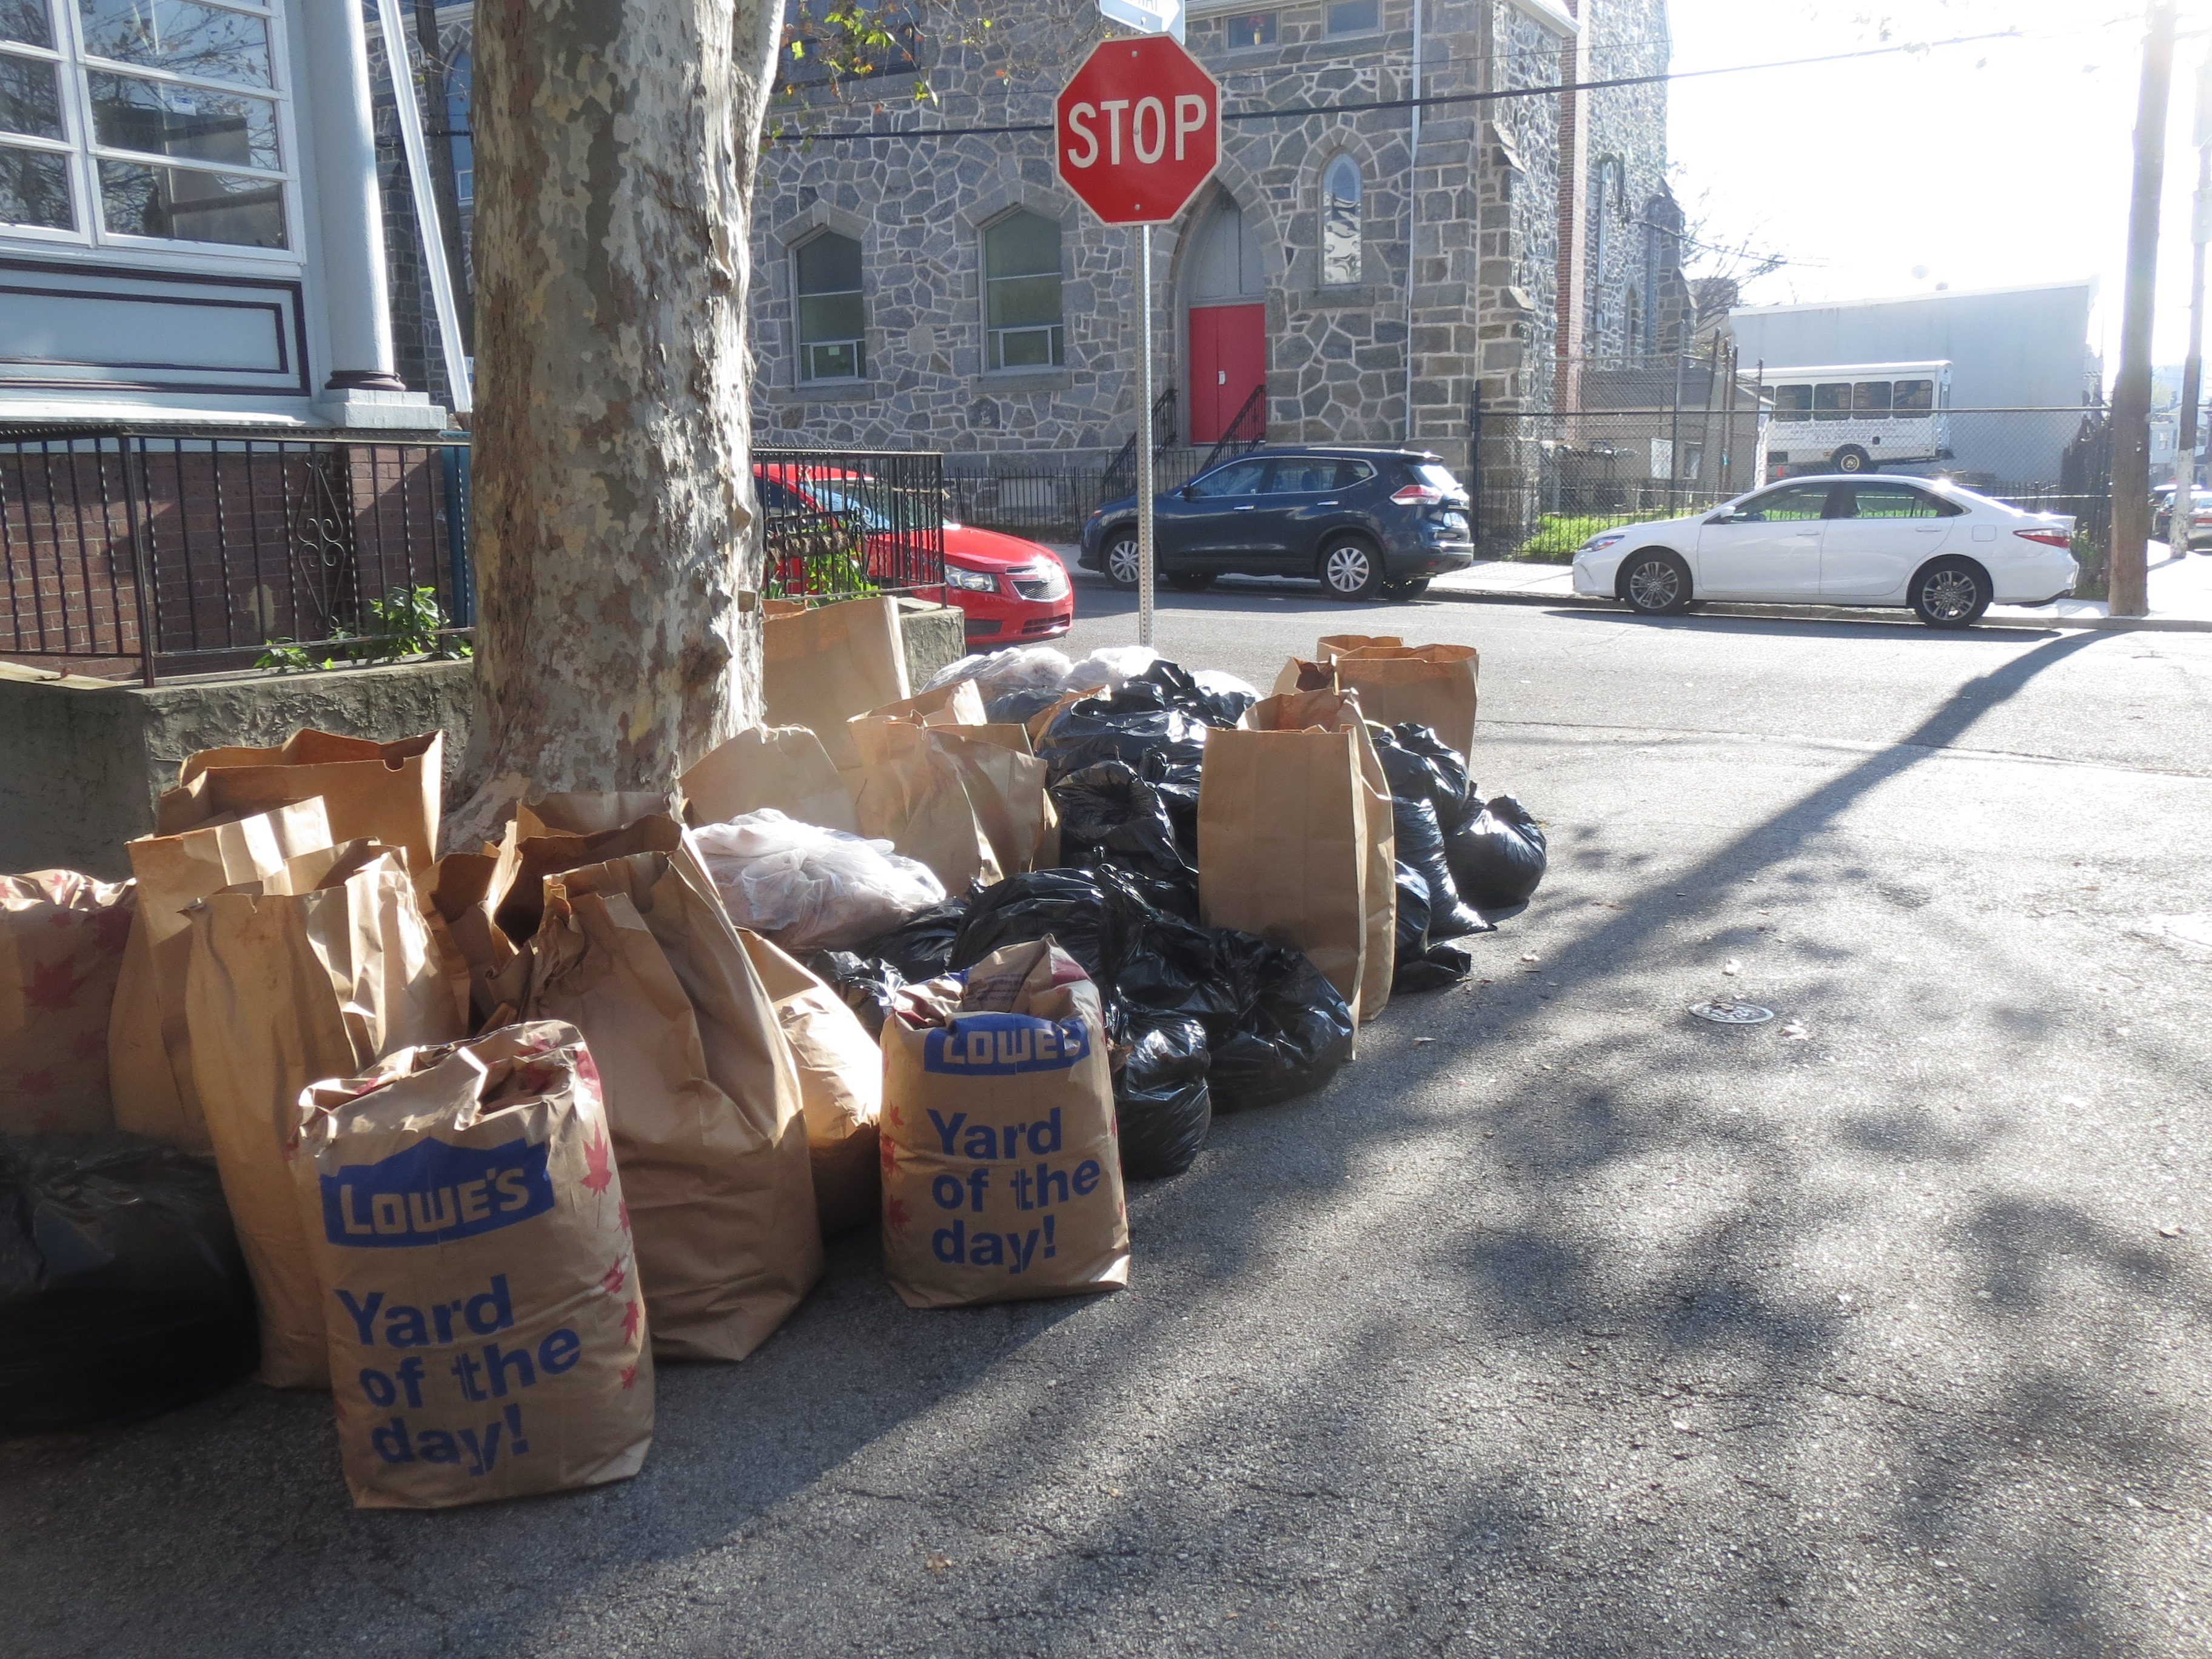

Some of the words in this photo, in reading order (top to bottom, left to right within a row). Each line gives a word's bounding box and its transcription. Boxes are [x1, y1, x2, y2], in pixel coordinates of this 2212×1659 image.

[1067, 94, 1207, 169] STOP
[943, 1028, 1081, 1064] LOWE
[927, 1107, 1062, 1159] Yard
[340, 1168, 529, 1235] LOWE'S
[932, 1168, 989, 1213] of
[1011, 1158, 1101, 1211] the
[932, 1215, 1056, 1273] day!
[333, 1274, 515, 1349] Yard
[359, 1356, 425, 1409] of
[452, 1327, 581, 1402] the
[370, 1403, 530, 1476] day!
